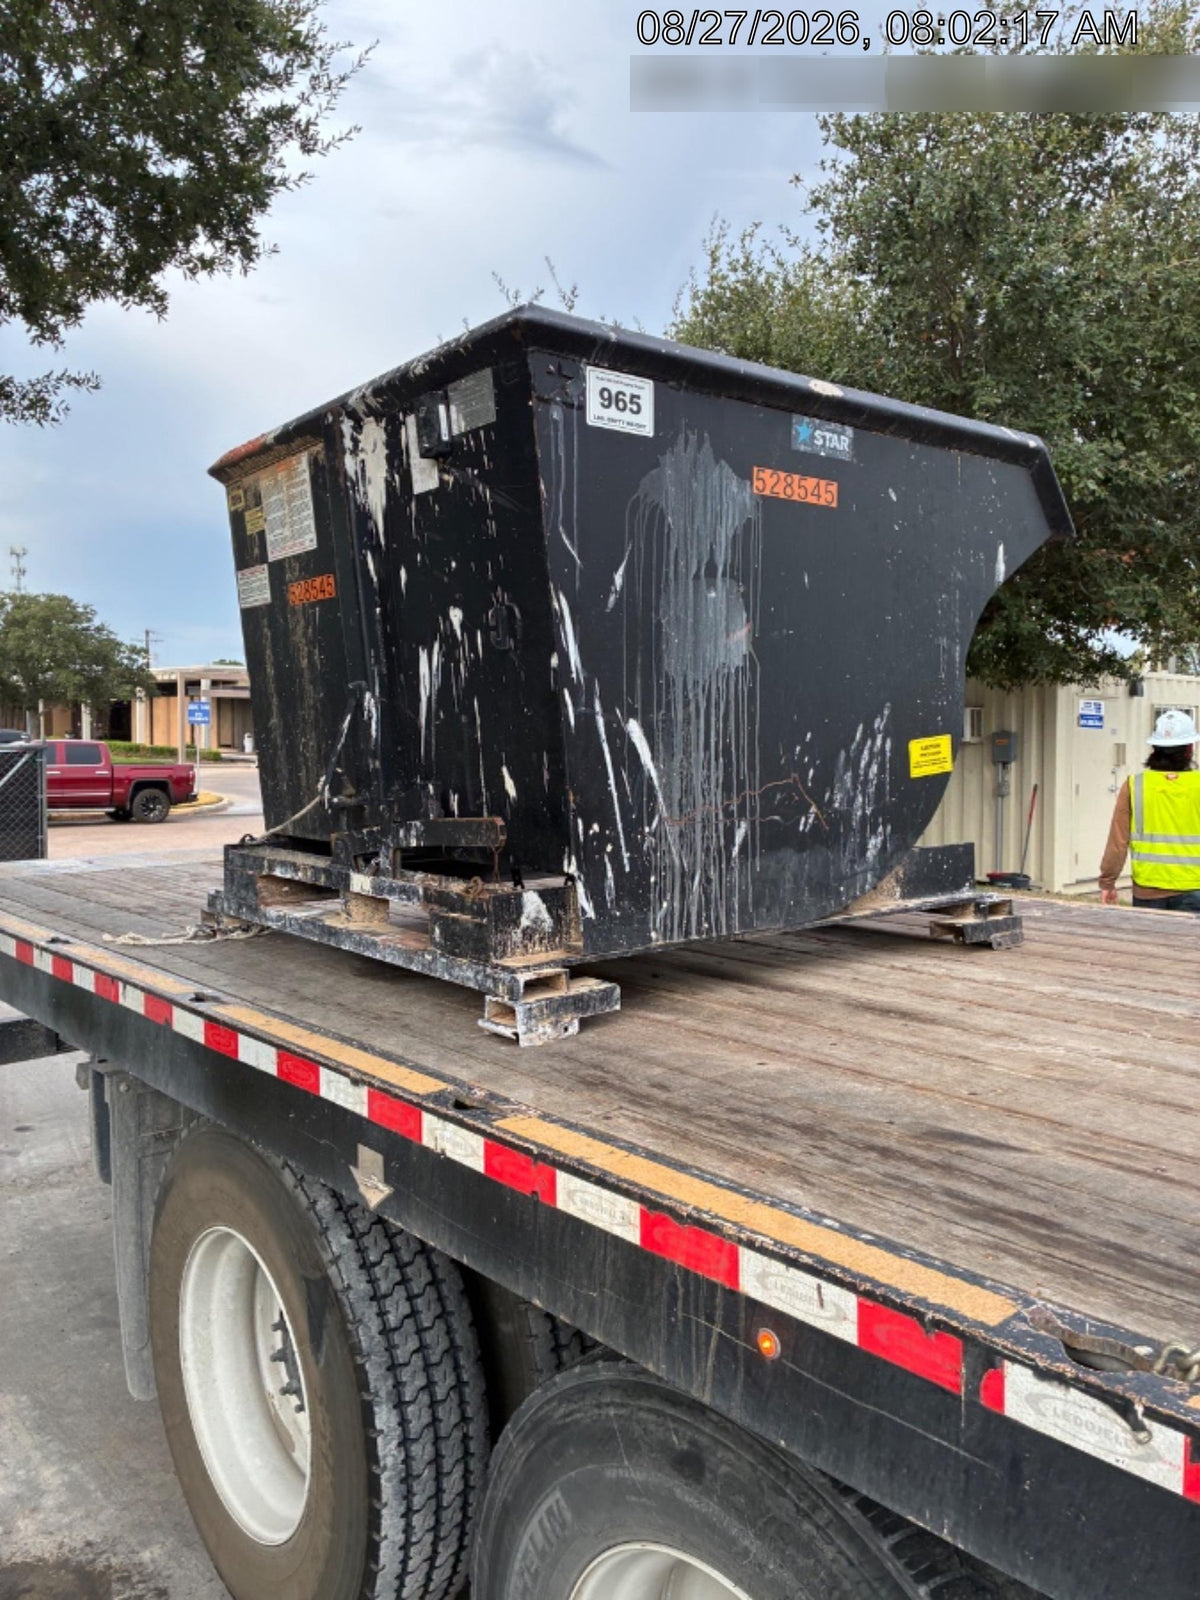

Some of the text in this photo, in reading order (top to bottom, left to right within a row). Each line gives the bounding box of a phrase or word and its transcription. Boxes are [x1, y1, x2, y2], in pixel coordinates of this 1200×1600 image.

[599, 387, 642, 415] 965
[813, 429, 850, 452] STAR
[754, 468, 837, 505] 528545
[290, 576, 335, 604] 528545
